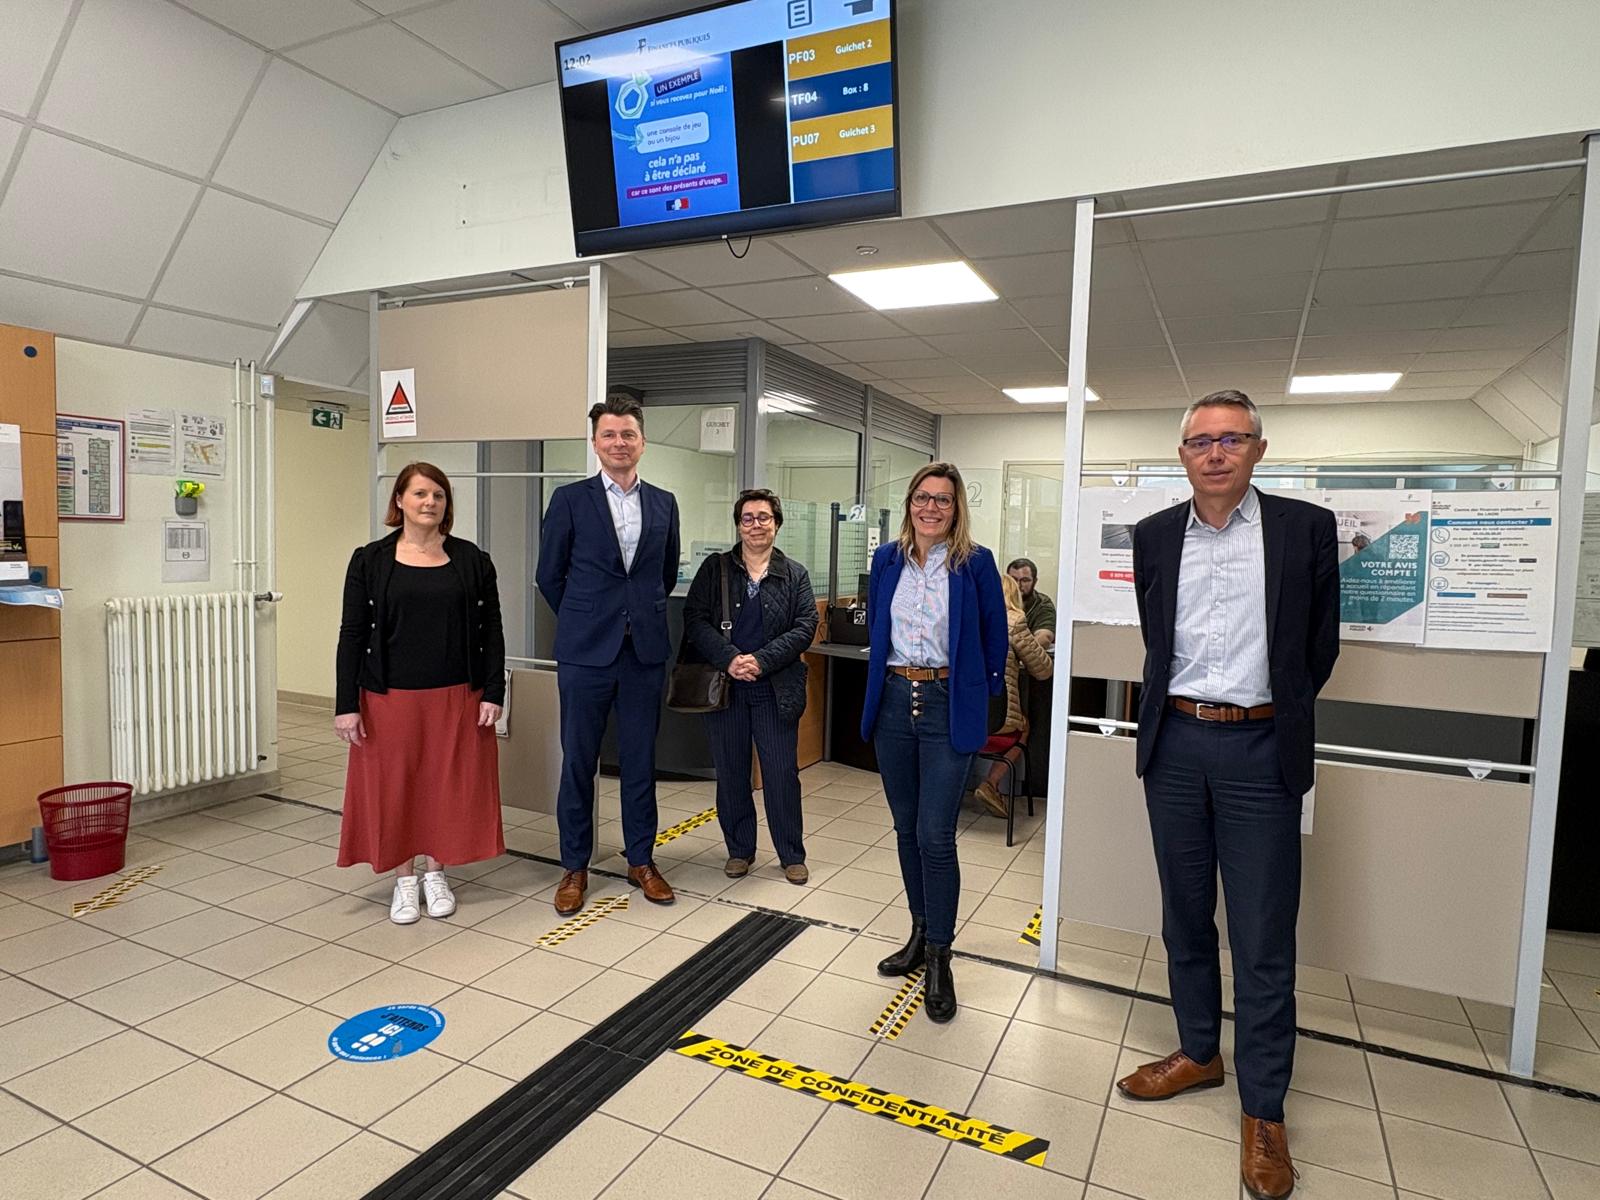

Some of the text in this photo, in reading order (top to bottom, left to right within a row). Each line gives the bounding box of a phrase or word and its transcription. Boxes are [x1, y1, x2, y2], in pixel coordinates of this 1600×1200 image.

[836, 39, 872, 54] Guichet 2
[564, 54, 591, 70] 12:02
[788, 50, 816, 64] PF03
[656, 72, 699, 94] UN EXEMPLE
[842, 86, 858, 96] Box
[863, 82, 869, 92] 8
[656, 97, 669, 105] vous
[670, 94, 692, 103] recevez
[693, 90, 708, 100] pour
[709, 84, 724, 95] Noël
[791, 91, 818, 105] TF04
[659, 125, 682, 135] console
[692, 121, 702, 131] jeu
[839, 124, 876, 138] Guichet 3
[666, 134, 680, 143] bijou
[792, 133, 820, 147] PU07
[648, 152, 700, 168] cela n'a pas
[644, 162, 706, 182] à être déclaré
[649, 186, 661, 194] sont
[674, 181, 698, 192] présents
[699, 177, 723, 187] d'usage.
[966, 481, 982, 508] 2
[1338, 518, 1358, 528] UEIL
[910, 986, 920, 994] DE
[880, 994, 914, 1036] CIRCULATION
[378, 1022, 405, 1037] ICI
[706, 1046, 1008, 1146] ZONE DE CONFIDENTIALITÉ
